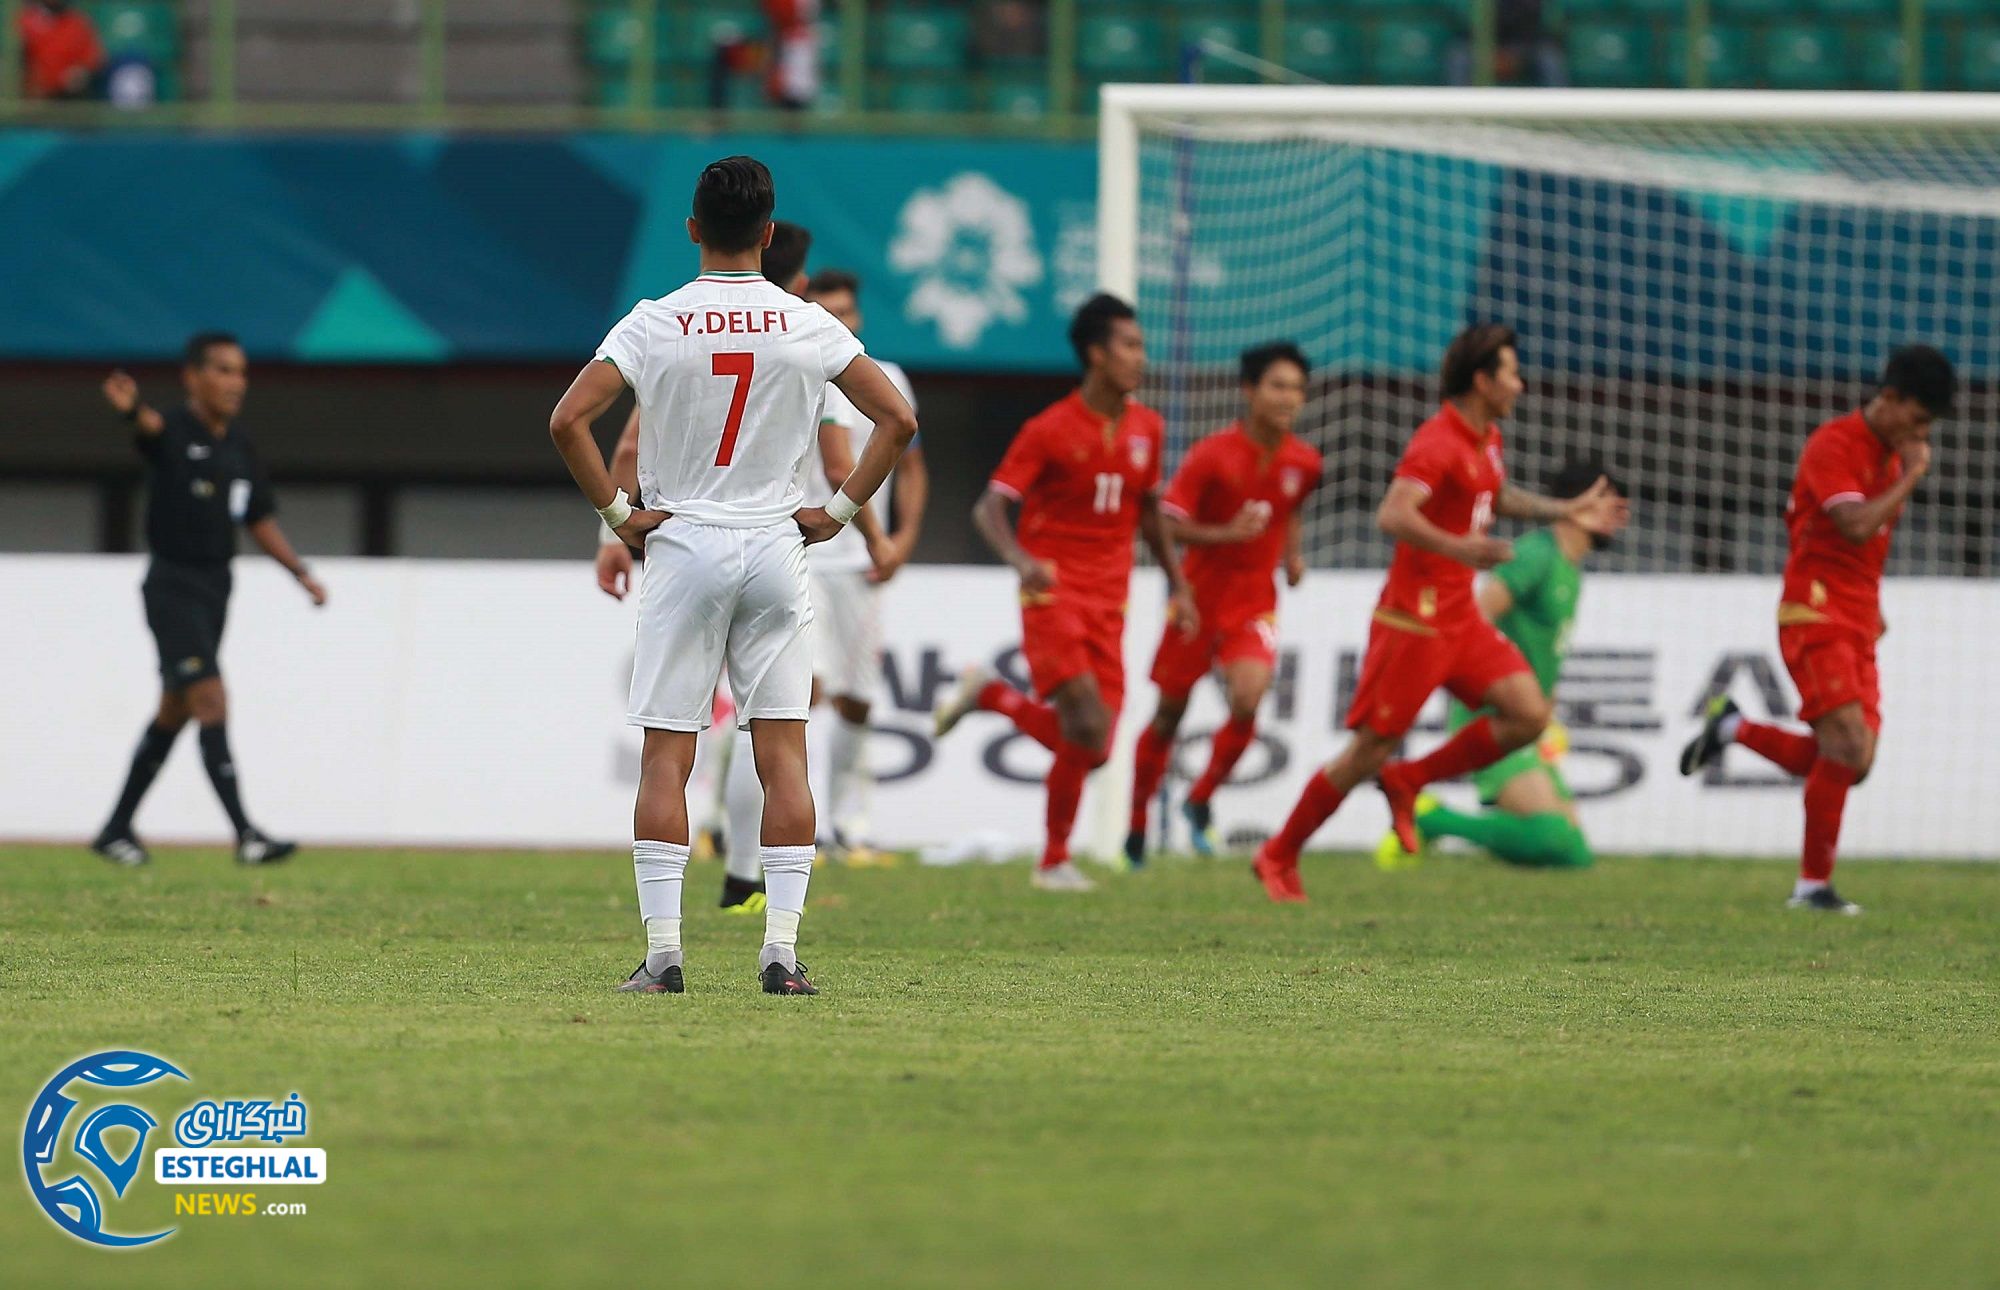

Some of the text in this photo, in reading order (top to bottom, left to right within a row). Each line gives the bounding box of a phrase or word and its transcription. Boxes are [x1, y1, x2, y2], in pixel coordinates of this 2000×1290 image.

[675, 310, 788, 336] Y.DELFI
[711, 352, 755, 467] 7
[1094, 472, 1124, 513] 11
